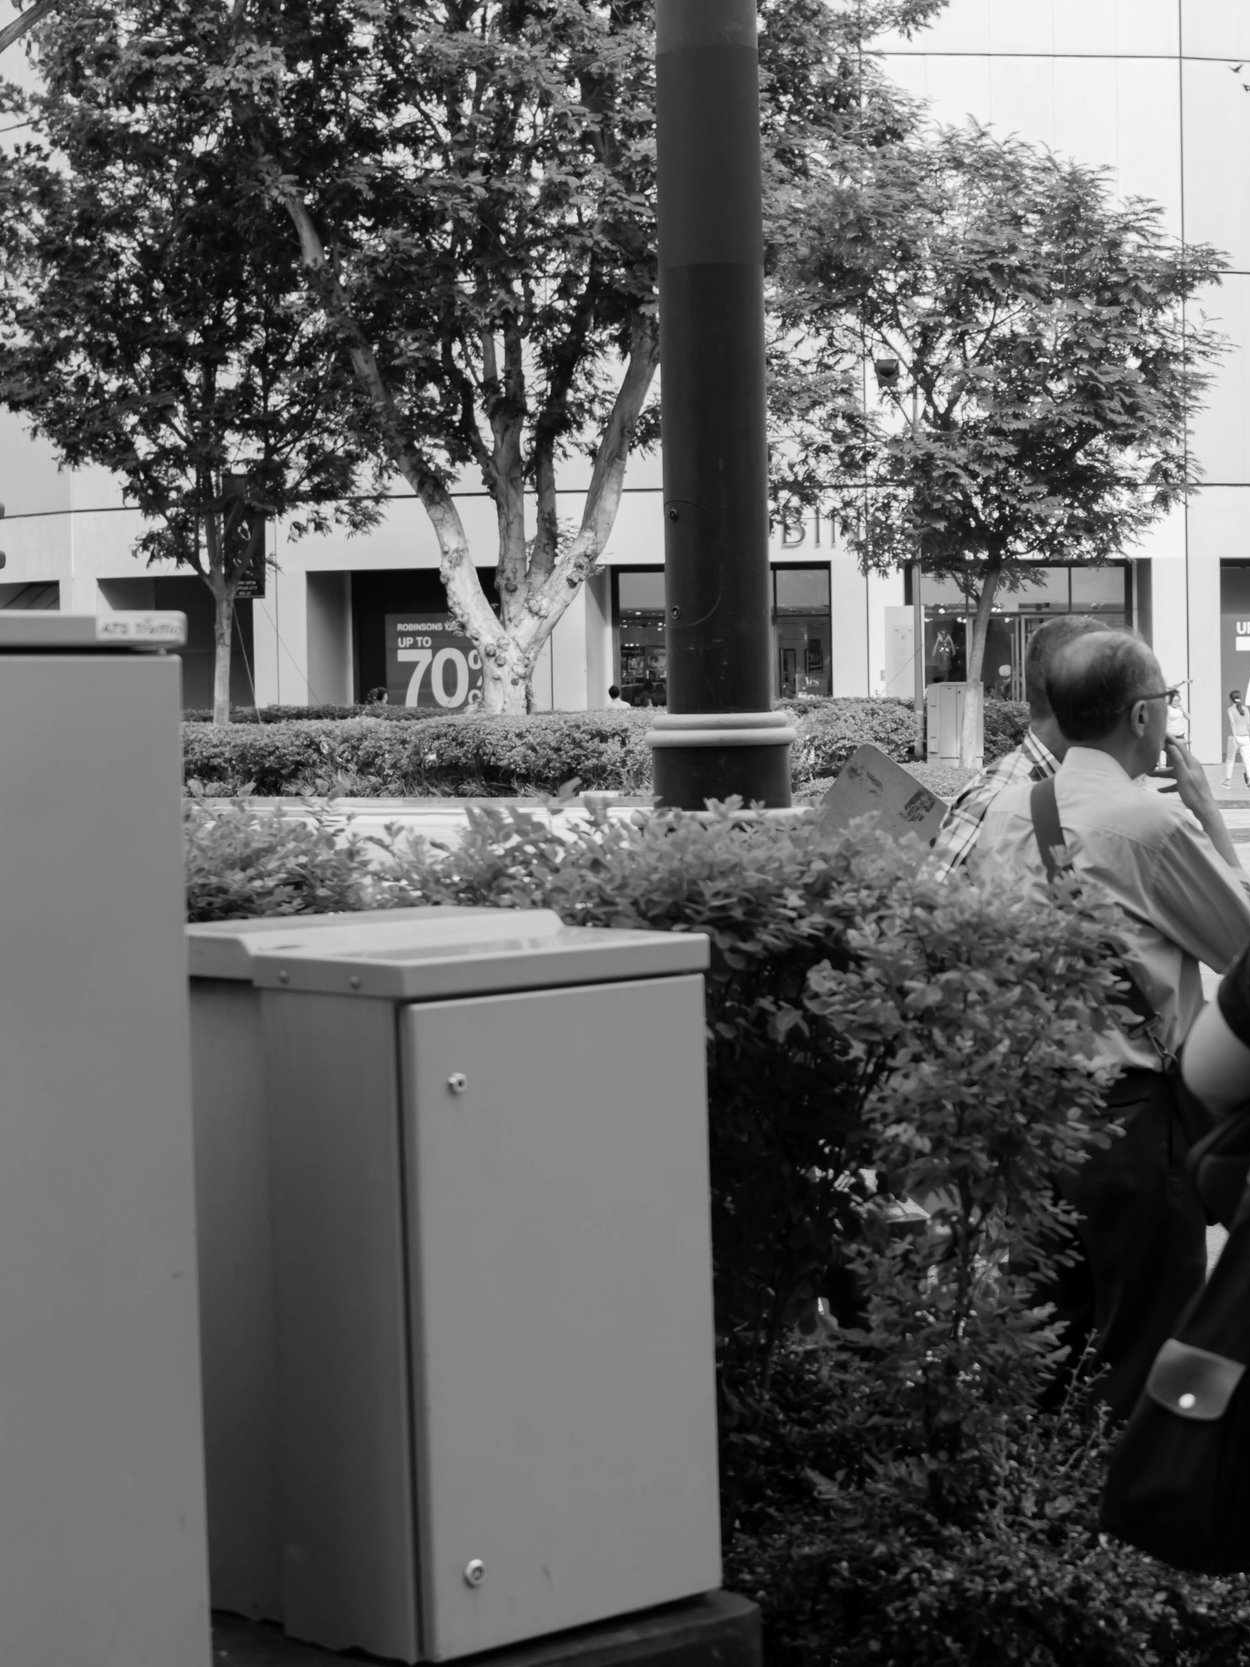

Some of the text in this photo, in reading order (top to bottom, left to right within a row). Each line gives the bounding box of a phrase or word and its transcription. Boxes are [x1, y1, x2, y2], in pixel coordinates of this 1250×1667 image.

[397, 622, 443, 631] ROBINSONS
[398, 637, 432, 647] UP TO
